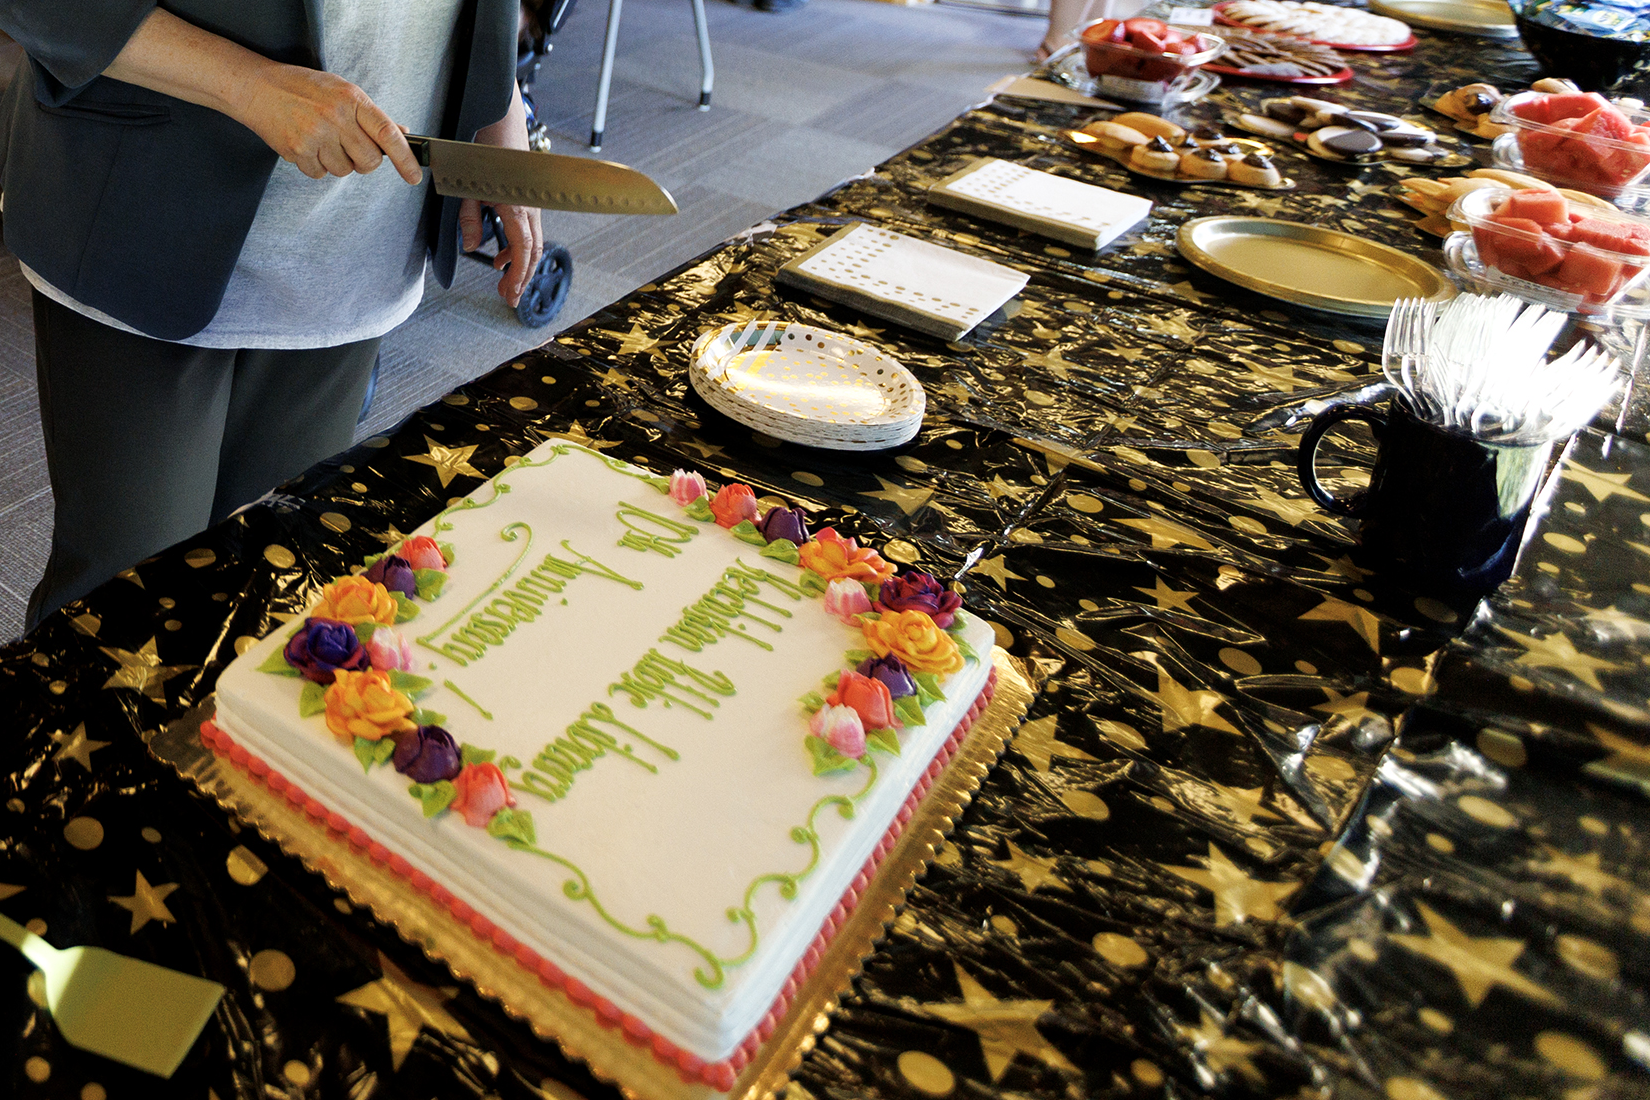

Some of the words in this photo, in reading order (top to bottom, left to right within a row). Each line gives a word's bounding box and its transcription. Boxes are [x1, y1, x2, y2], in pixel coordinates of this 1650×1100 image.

[658, 556, 818, 652] Ketchikan
[608, 647, 737, 721] Public
[500, 702, 681, 802] Library
